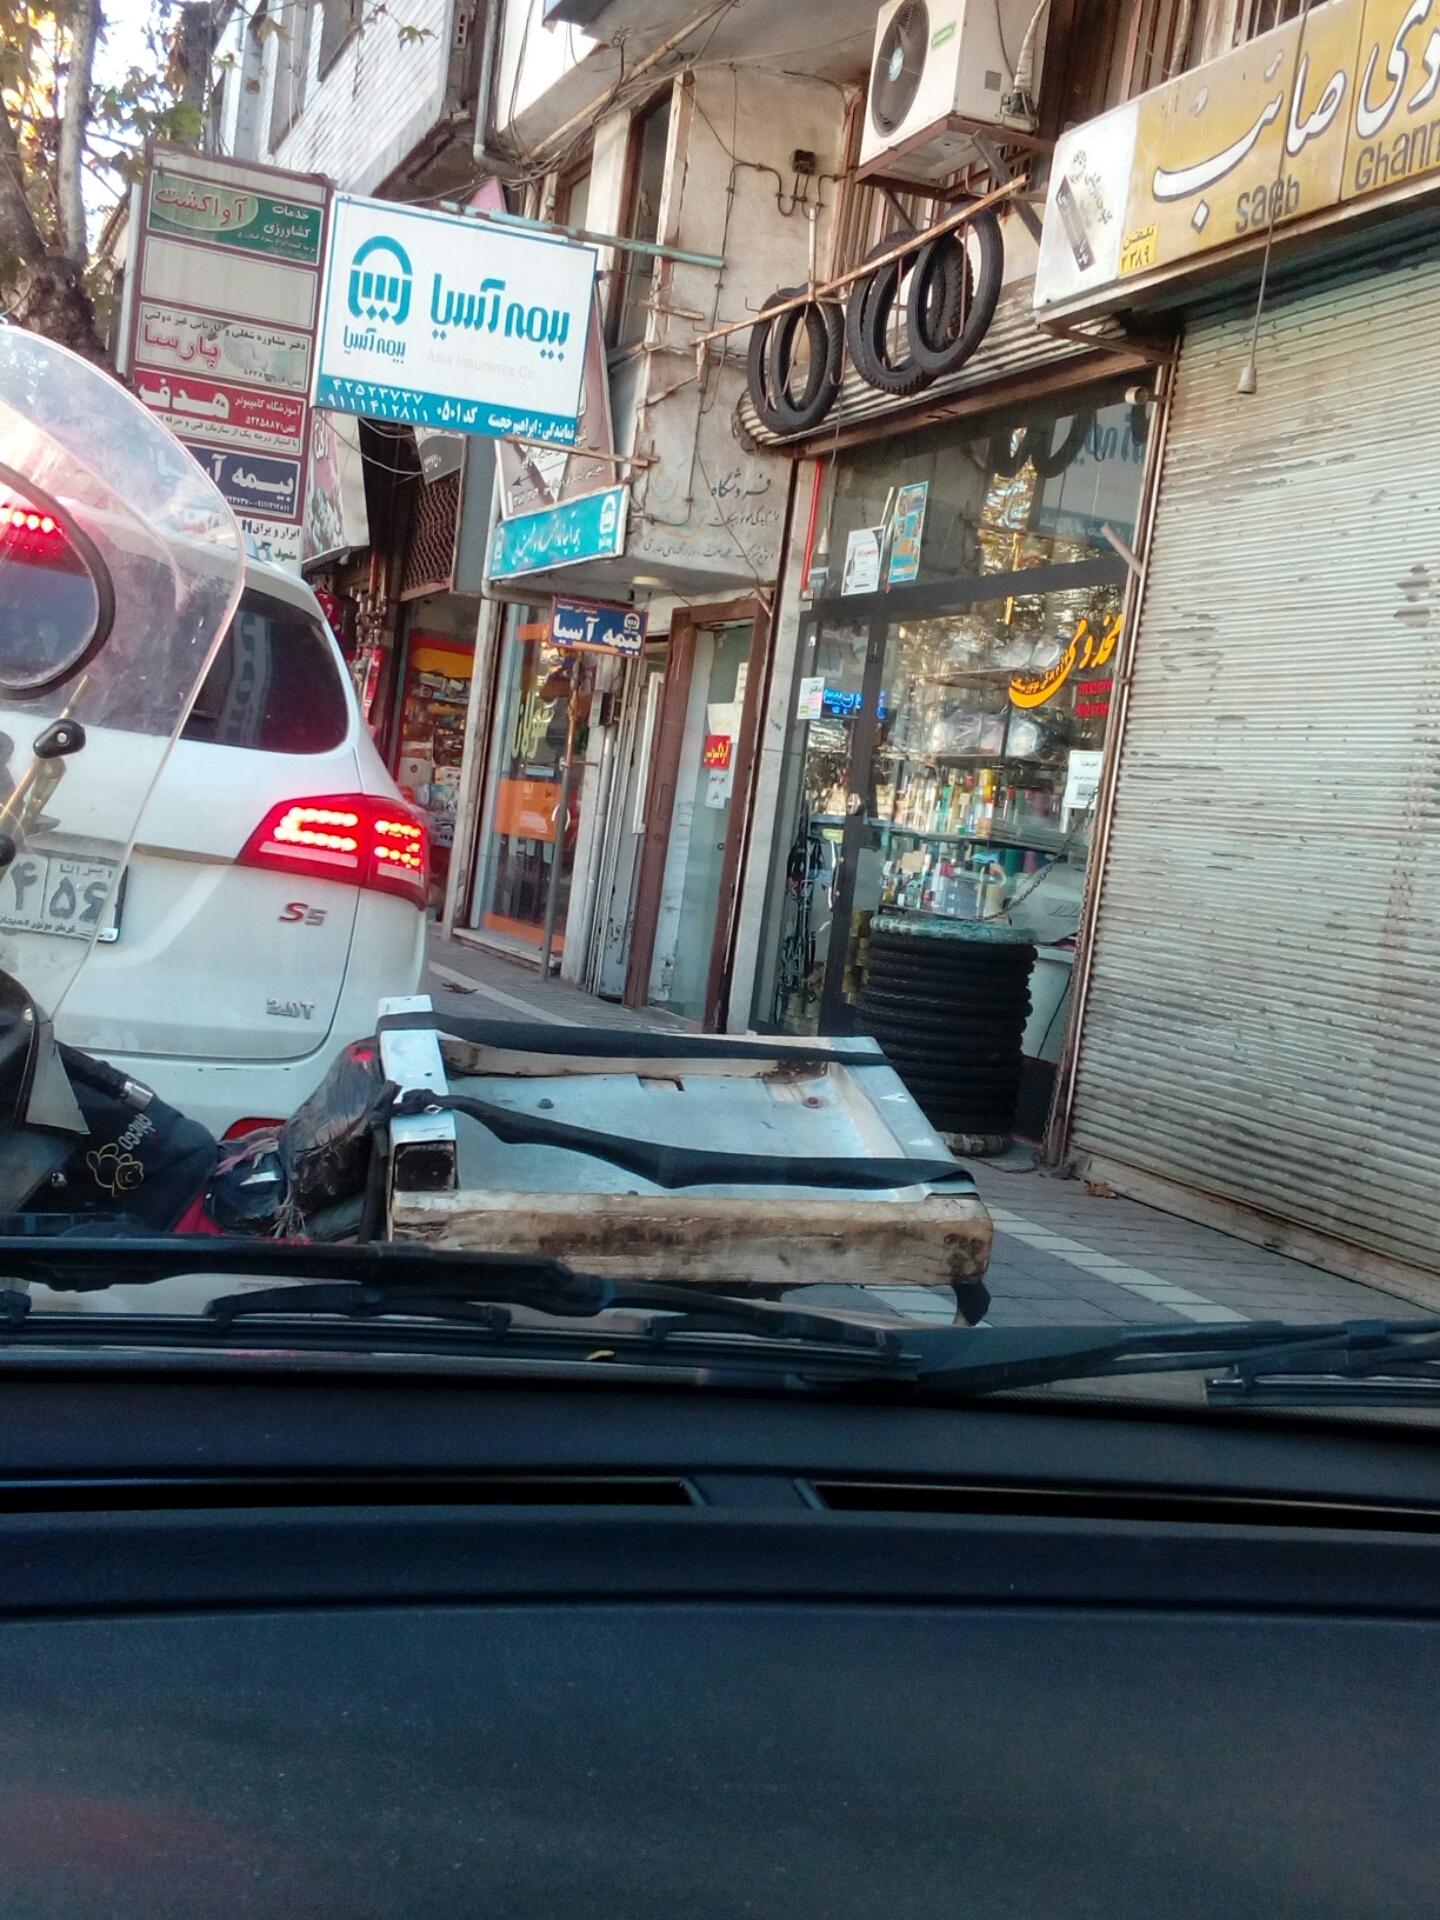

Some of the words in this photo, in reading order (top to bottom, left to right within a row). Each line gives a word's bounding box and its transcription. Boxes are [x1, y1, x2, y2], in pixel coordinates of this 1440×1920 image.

[272, 205, 309, 220] خدمات
[1235, 174, 1301, 235] saeb
[263, 222, 311, 238] کشاورزی
[430, 272, 506, 341] آسیا
[144, 325, 221, 369] پارسا
[343, 325, 377, 356] آسیا
[504, 302, 570, 363] بیمه
[377, 338, 407, 365] بیمه
[138, 377, 230, 420] هدف
[332, 378, 424, 406] ۴۲۵۲۳۷۳۷
[318, 394, 429, 421] ۰۹۱۱۱۴۱۲۸۱۱
[231, 466, 293, 502] بیمه
[711, 468, 772, 498] فروشگاه
[553, 613, 600, 644] آسیا
[602, 628, 641, 656] بیمه
[278, 901, 328, 926] S5
